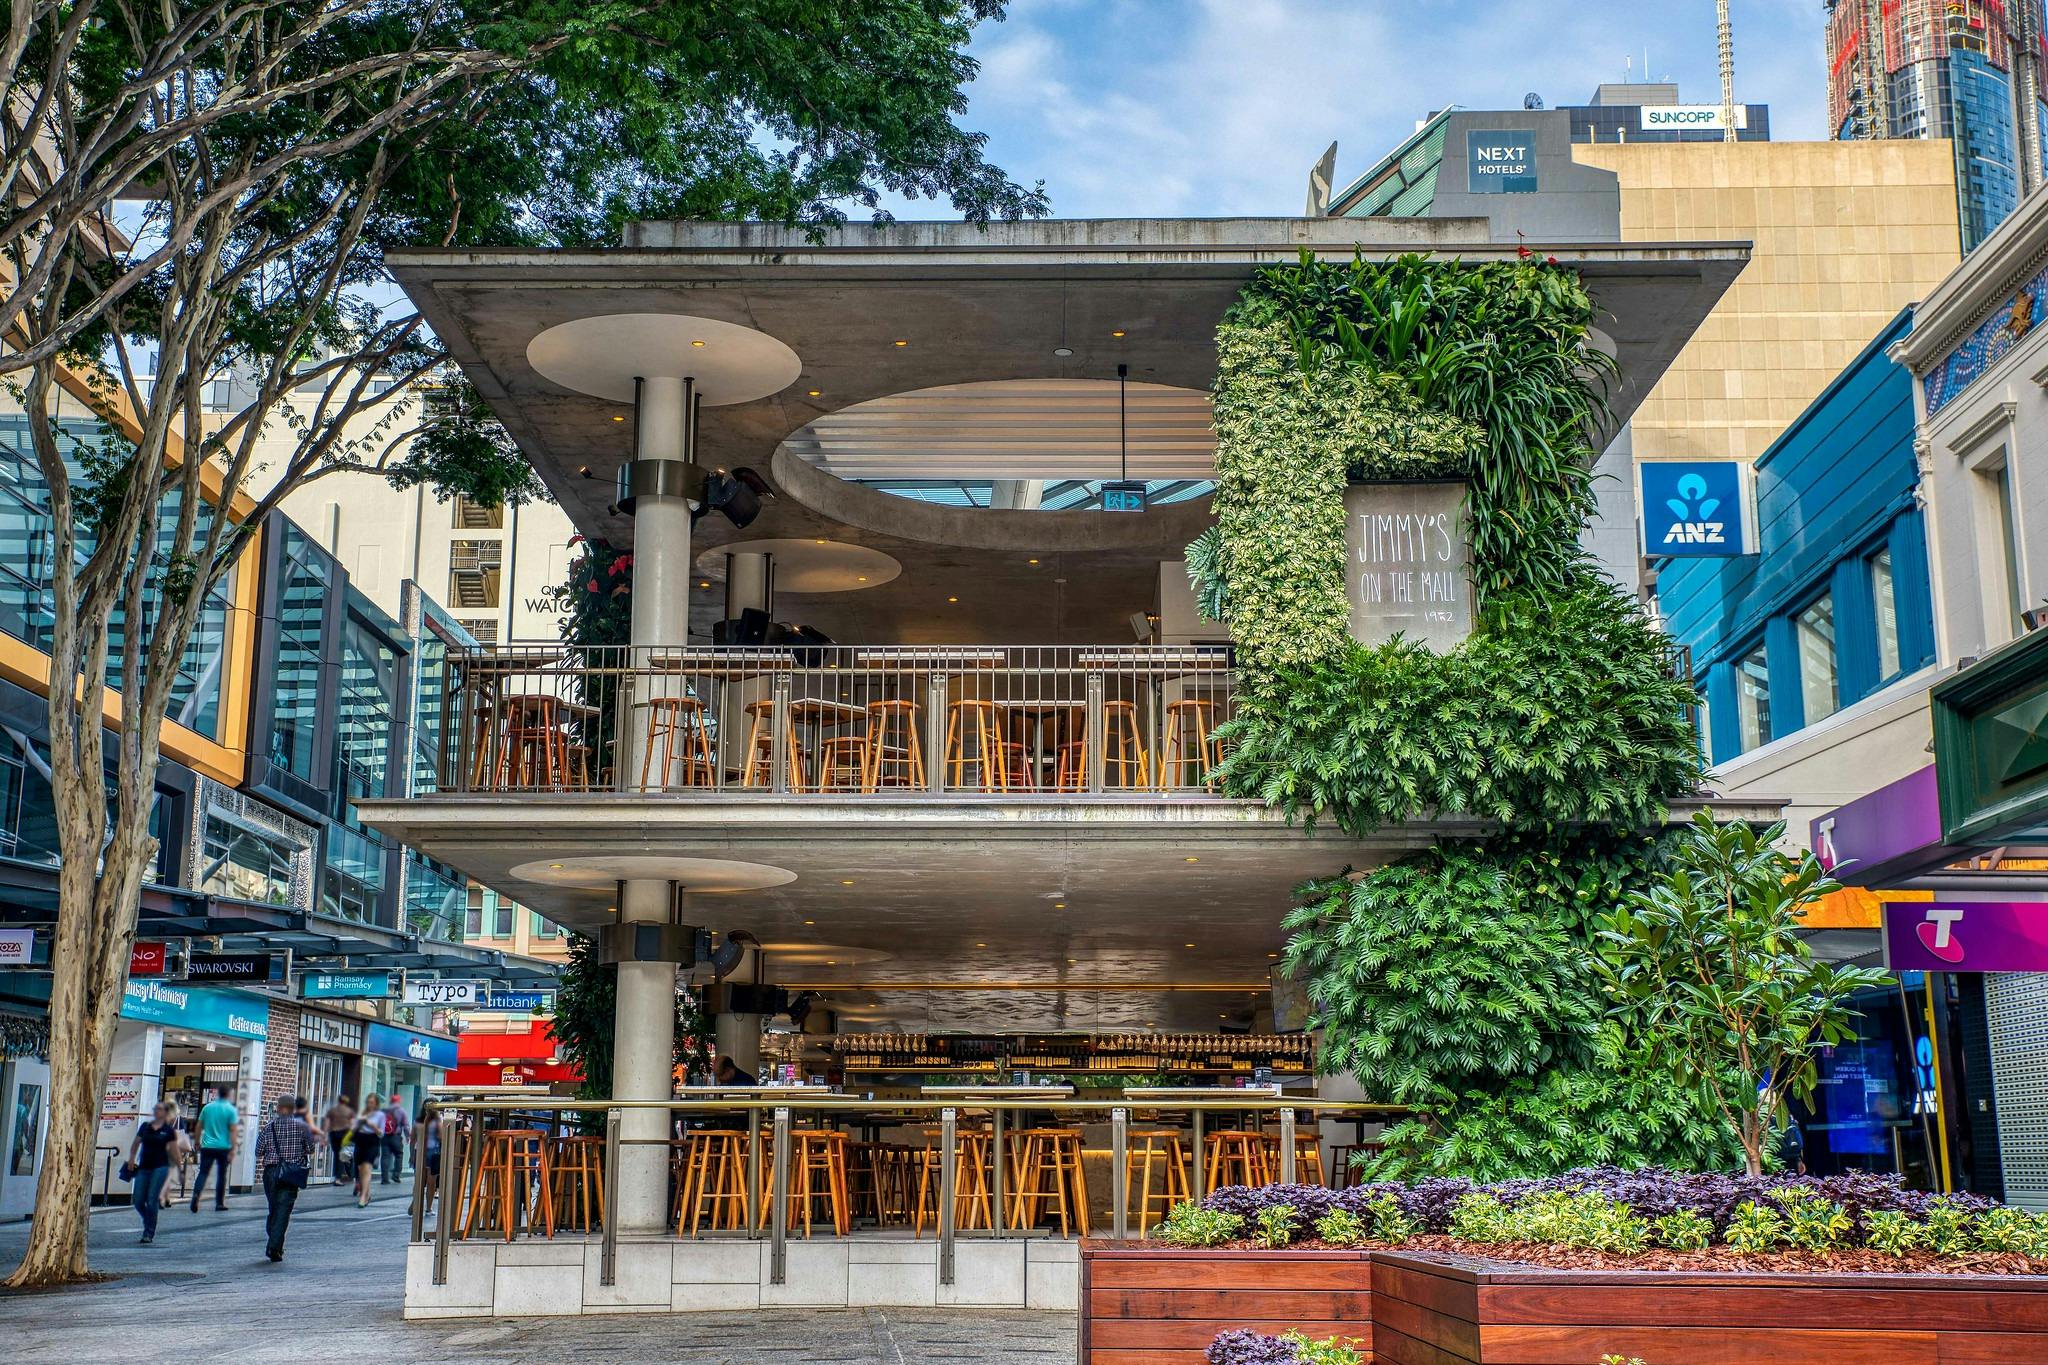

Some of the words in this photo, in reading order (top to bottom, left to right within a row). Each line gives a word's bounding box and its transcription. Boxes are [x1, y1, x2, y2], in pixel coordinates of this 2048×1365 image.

[1649, 111, 1715, 124] SUNCORP
[1477, 147, 1526, 162] NEXT
[1478, 165, 1524, 175] HOTELS
[1358, 513, 1451, 563] JIMMY'S
[1663, 522, 1725, 544] ANZ
[1360, 573, 1381, 603] ON
[1389, 572, 1414, 603] THE
[1421, 571, 1456, 602] MALL
[524, 598, 576, 613] WATC
[0, 942, 22, 953] OZA
[187, 963, 254, 974] SWAROVSKI
[334, 975, 365, 985] Ramsay
[334, 982, 373, 990] Pharmacy
[126, 981, 150, 1003] amsay
[149, 981, 188, 1010] Pharmacy
[418, 984, 468, 1002] Typo
[488, 996, 537, 1008] citibank
[1913, 1090, 1938, 1114] AN
